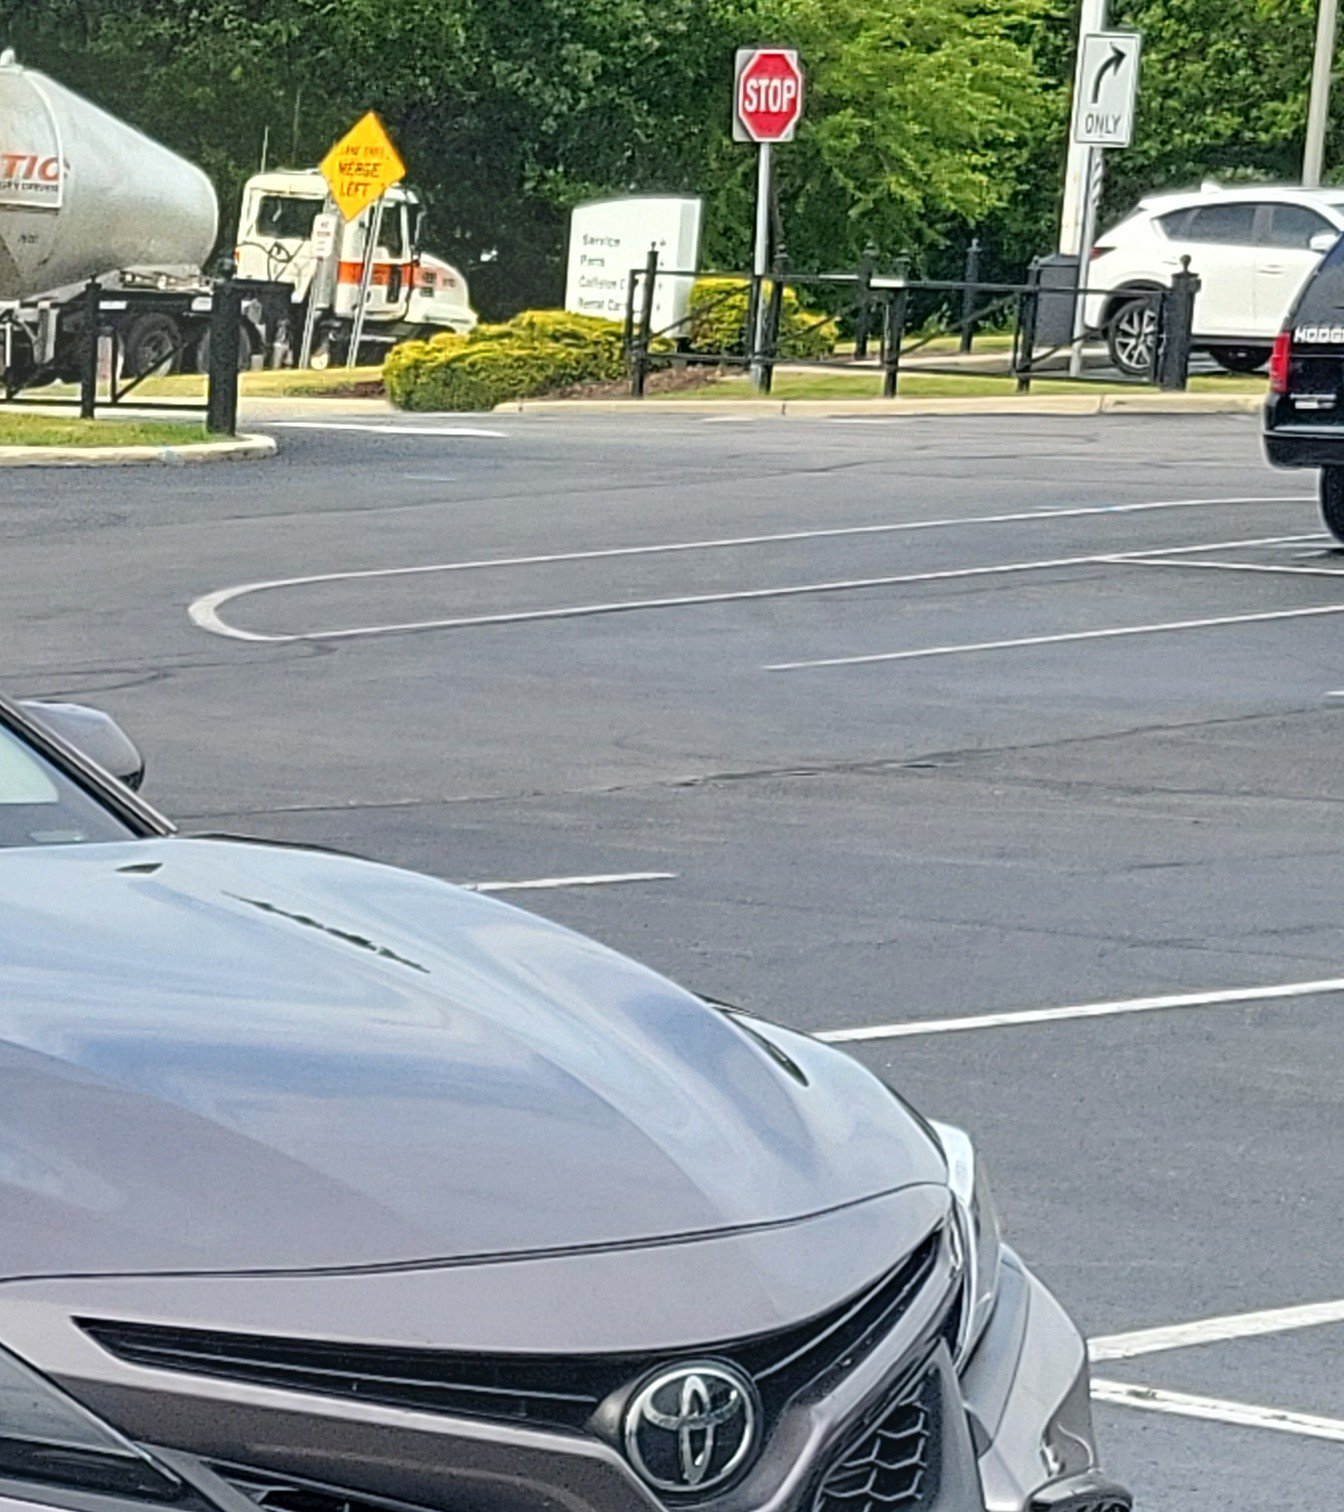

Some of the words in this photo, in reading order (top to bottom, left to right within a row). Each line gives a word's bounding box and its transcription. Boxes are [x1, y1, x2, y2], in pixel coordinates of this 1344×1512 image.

[744, 78, 796, 113] STOP
[1085, 113, 1121, 134] ONLY
[338, 181, 371, 197] LEFT
